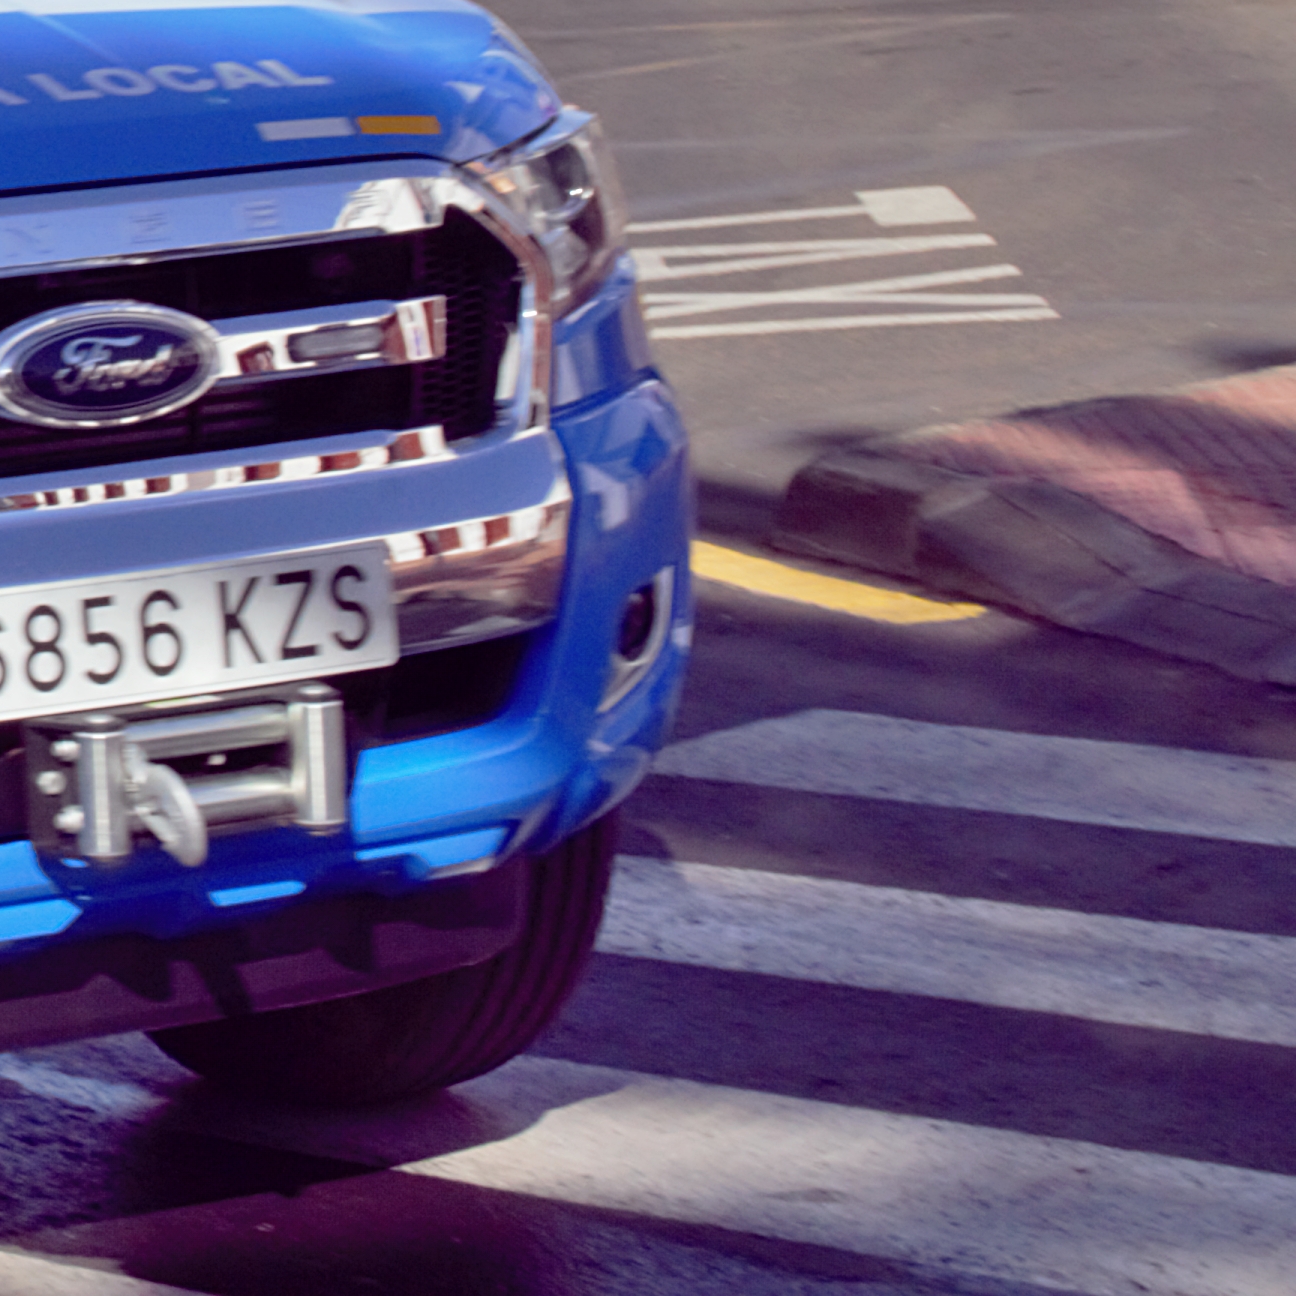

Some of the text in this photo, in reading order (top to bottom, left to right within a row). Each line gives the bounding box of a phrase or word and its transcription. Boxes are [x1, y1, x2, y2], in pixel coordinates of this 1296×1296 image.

[28, 59, 334, 102] LOCAL
[52, 334, 174, 396] Ford
[217, 564, 372, 669] KZS
